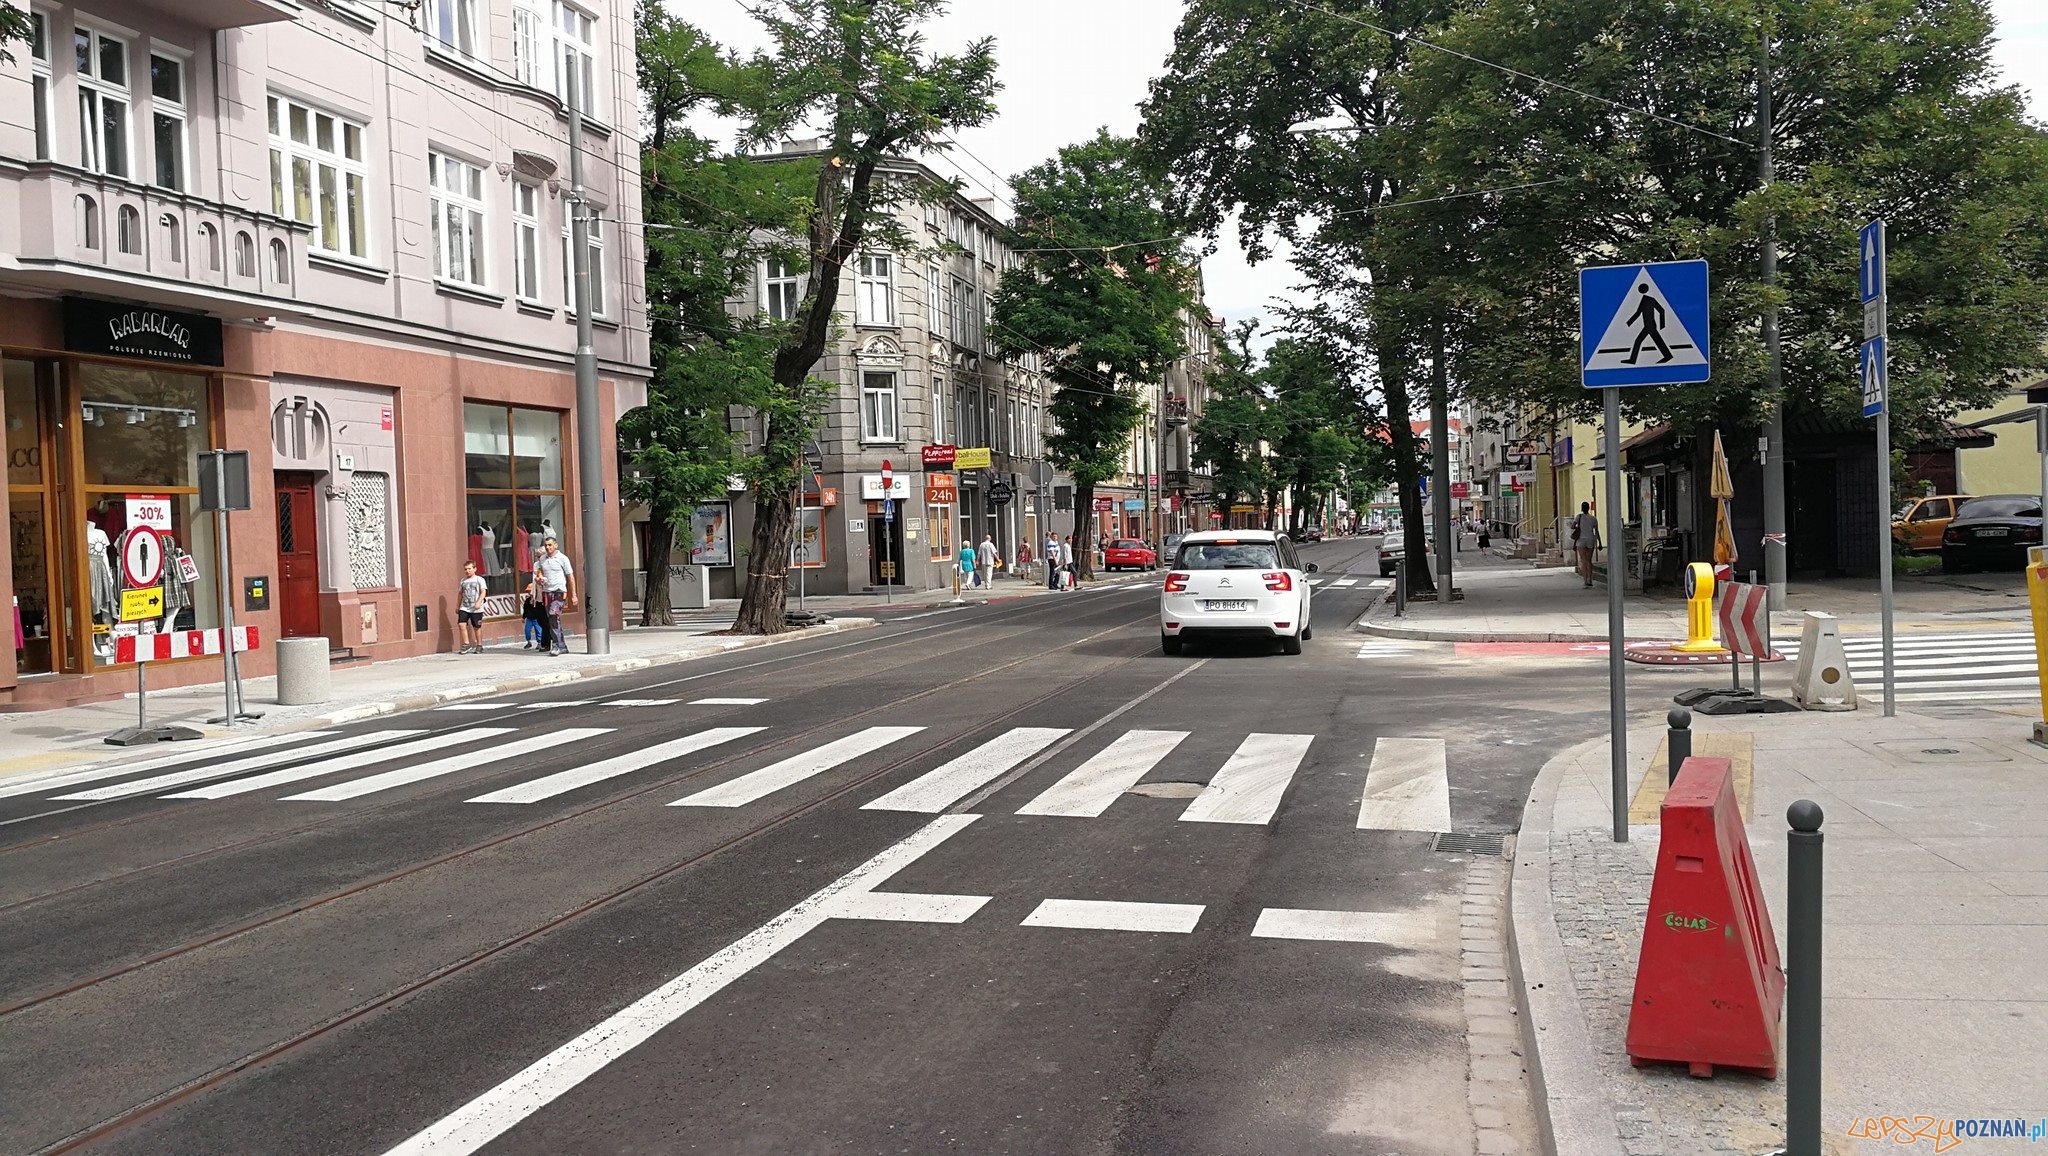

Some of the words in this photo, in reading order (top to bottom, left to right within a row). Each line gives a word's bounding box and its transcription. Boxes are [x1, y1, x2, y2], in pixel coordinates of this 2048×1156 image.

[109, 311, 190, 348] RABARBAR
[110, 345, 144, 355] POLSKIE
[824, 491, 835, 503] 24h
[931, 489, 953, 501] 24h
[134, 506, 164, 520] -30%
[1222, 601, 1245, 609] 8H614
[1665, 914, 1707, 930] COLAS
